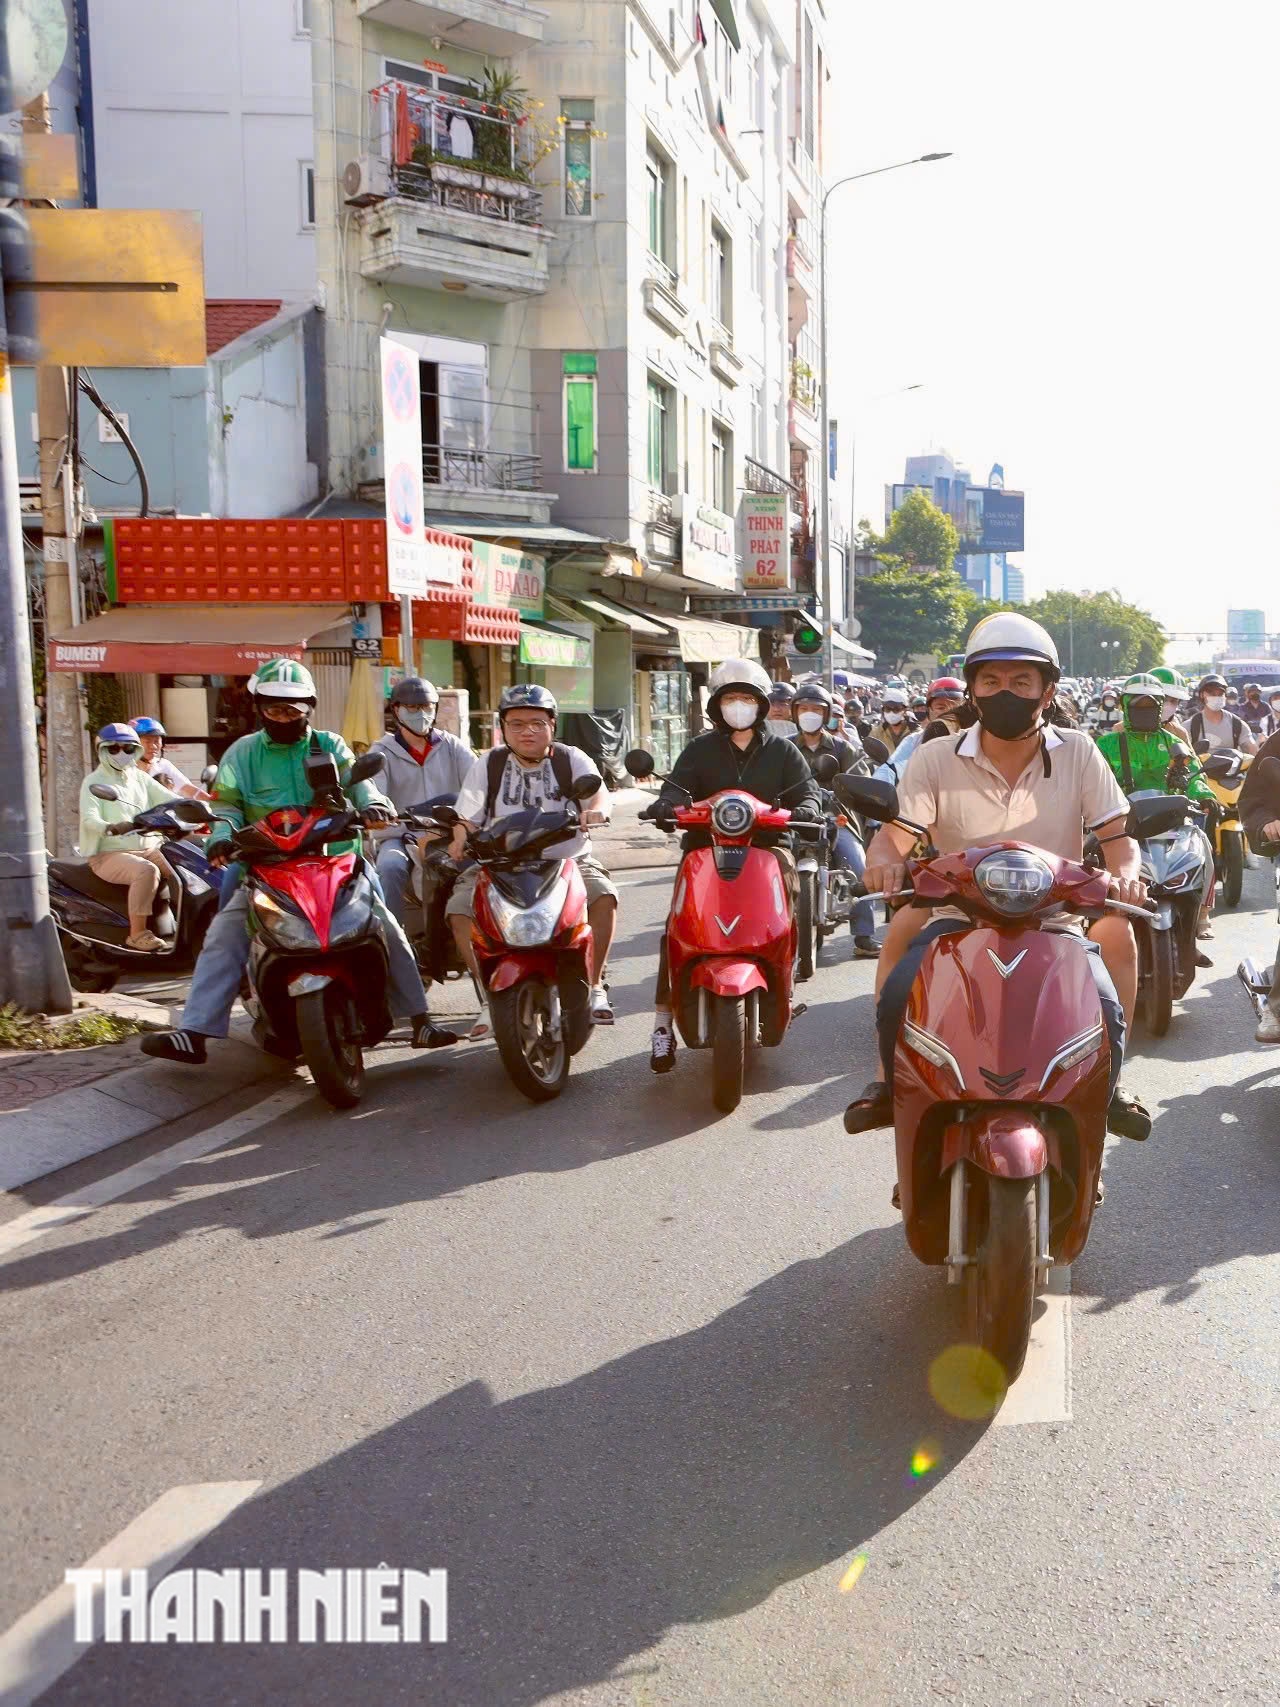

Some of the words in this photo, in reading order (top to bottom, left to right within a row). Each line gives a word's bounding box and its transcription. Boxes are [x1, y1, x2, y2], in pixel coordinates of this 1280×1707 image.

[747, 516, 783, 534] THỊNH
[756, 560, 776, 576] 62
[355, 640, 379, 650] 62
[56, 646, 107, 661] BUMERY
